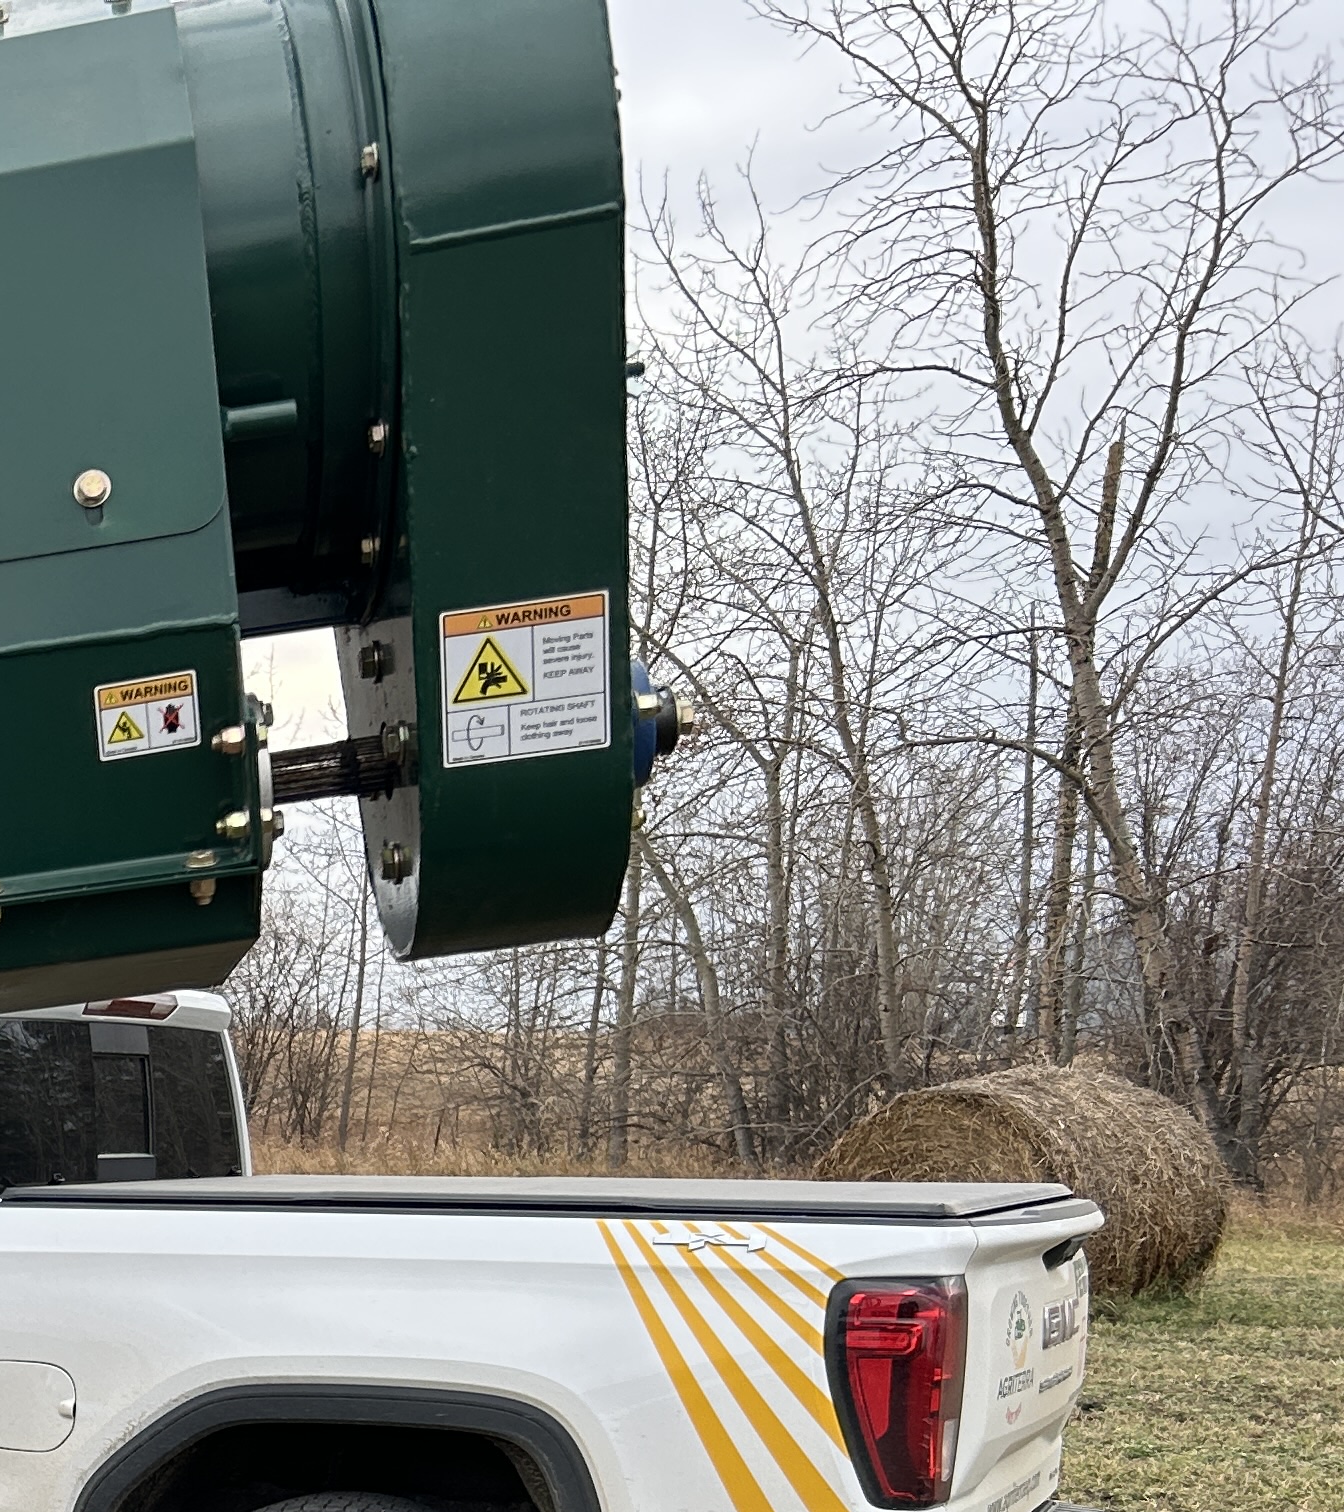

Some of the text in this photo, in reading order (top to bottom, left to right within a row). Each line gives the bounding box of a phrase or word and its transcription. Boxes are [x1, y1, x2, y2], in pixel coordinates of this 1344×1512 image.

[496, 604, 571, 625] WARNING
[542, 631, 593, 645] Moving Parts
[543, 666, 594, 678] KEEP AWAY
[120, 680, 188, 701] WARNING
[520, 700, 595, 716] ROTATING SHAFT
[521, 722, 540, 731] Keep
[520, 729, 573, 741] clothing away
